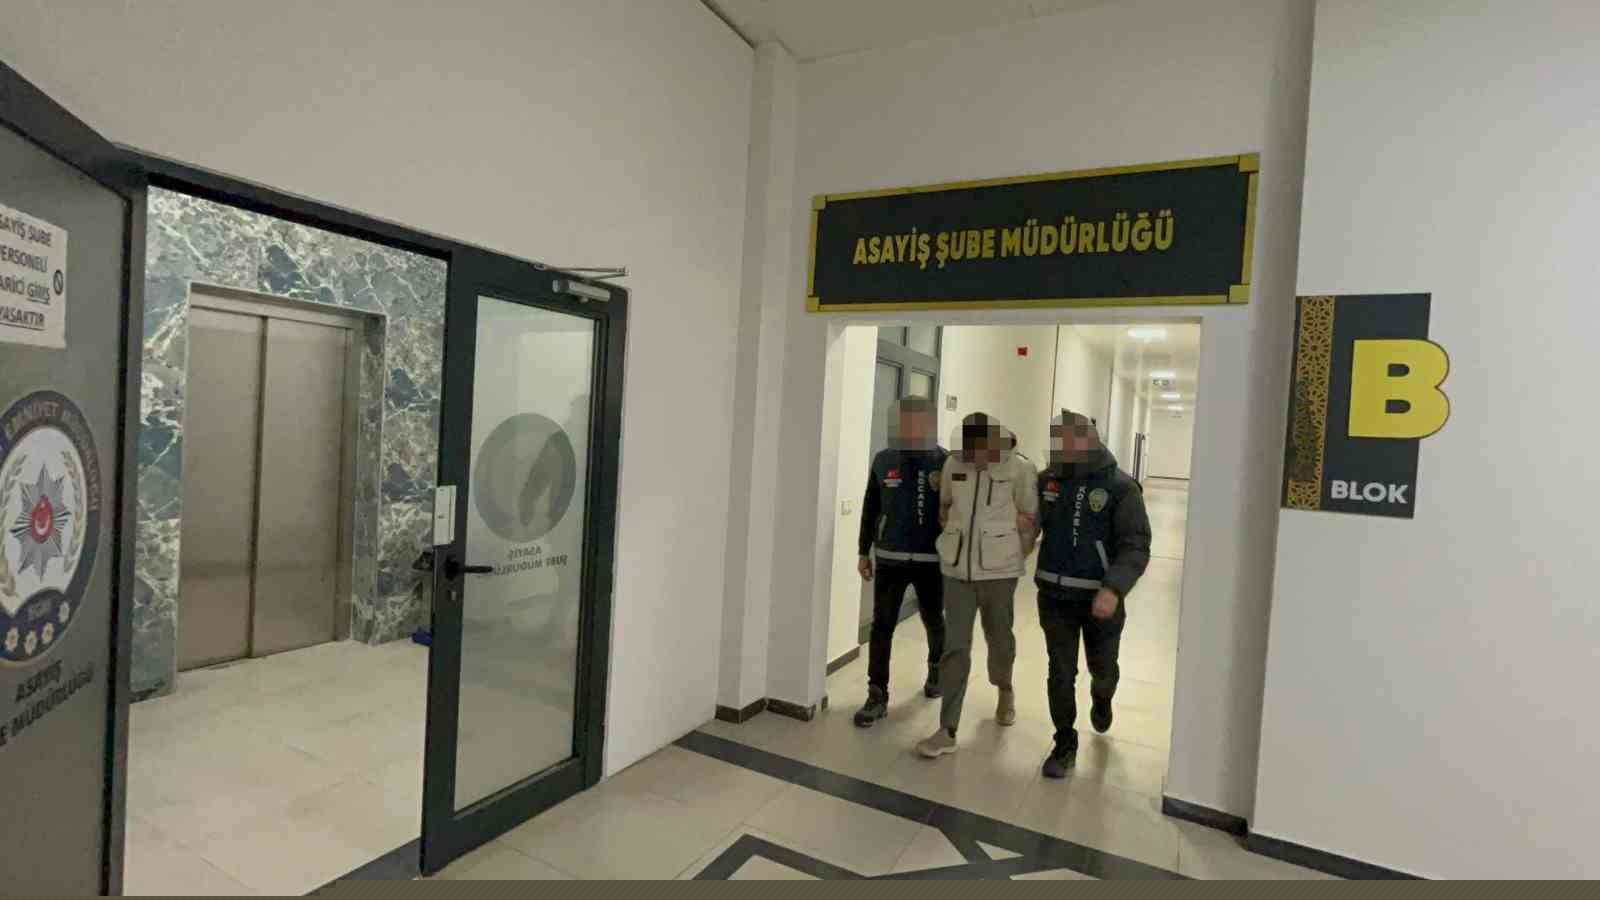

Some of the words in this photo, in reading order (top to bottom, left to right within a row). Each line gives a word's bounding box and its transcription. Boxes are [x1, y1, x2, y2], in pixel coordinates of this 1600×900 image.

[853, 226, 931, 270] ASAYİŞ
[936, 228, 996, 268] ŞUBE
[1001, 208, 1175, 258] MÜDÜRLÜĞÜ
[1347, 339, 1450, 439] B
[1331, 480, 1408, 504] BLOK
